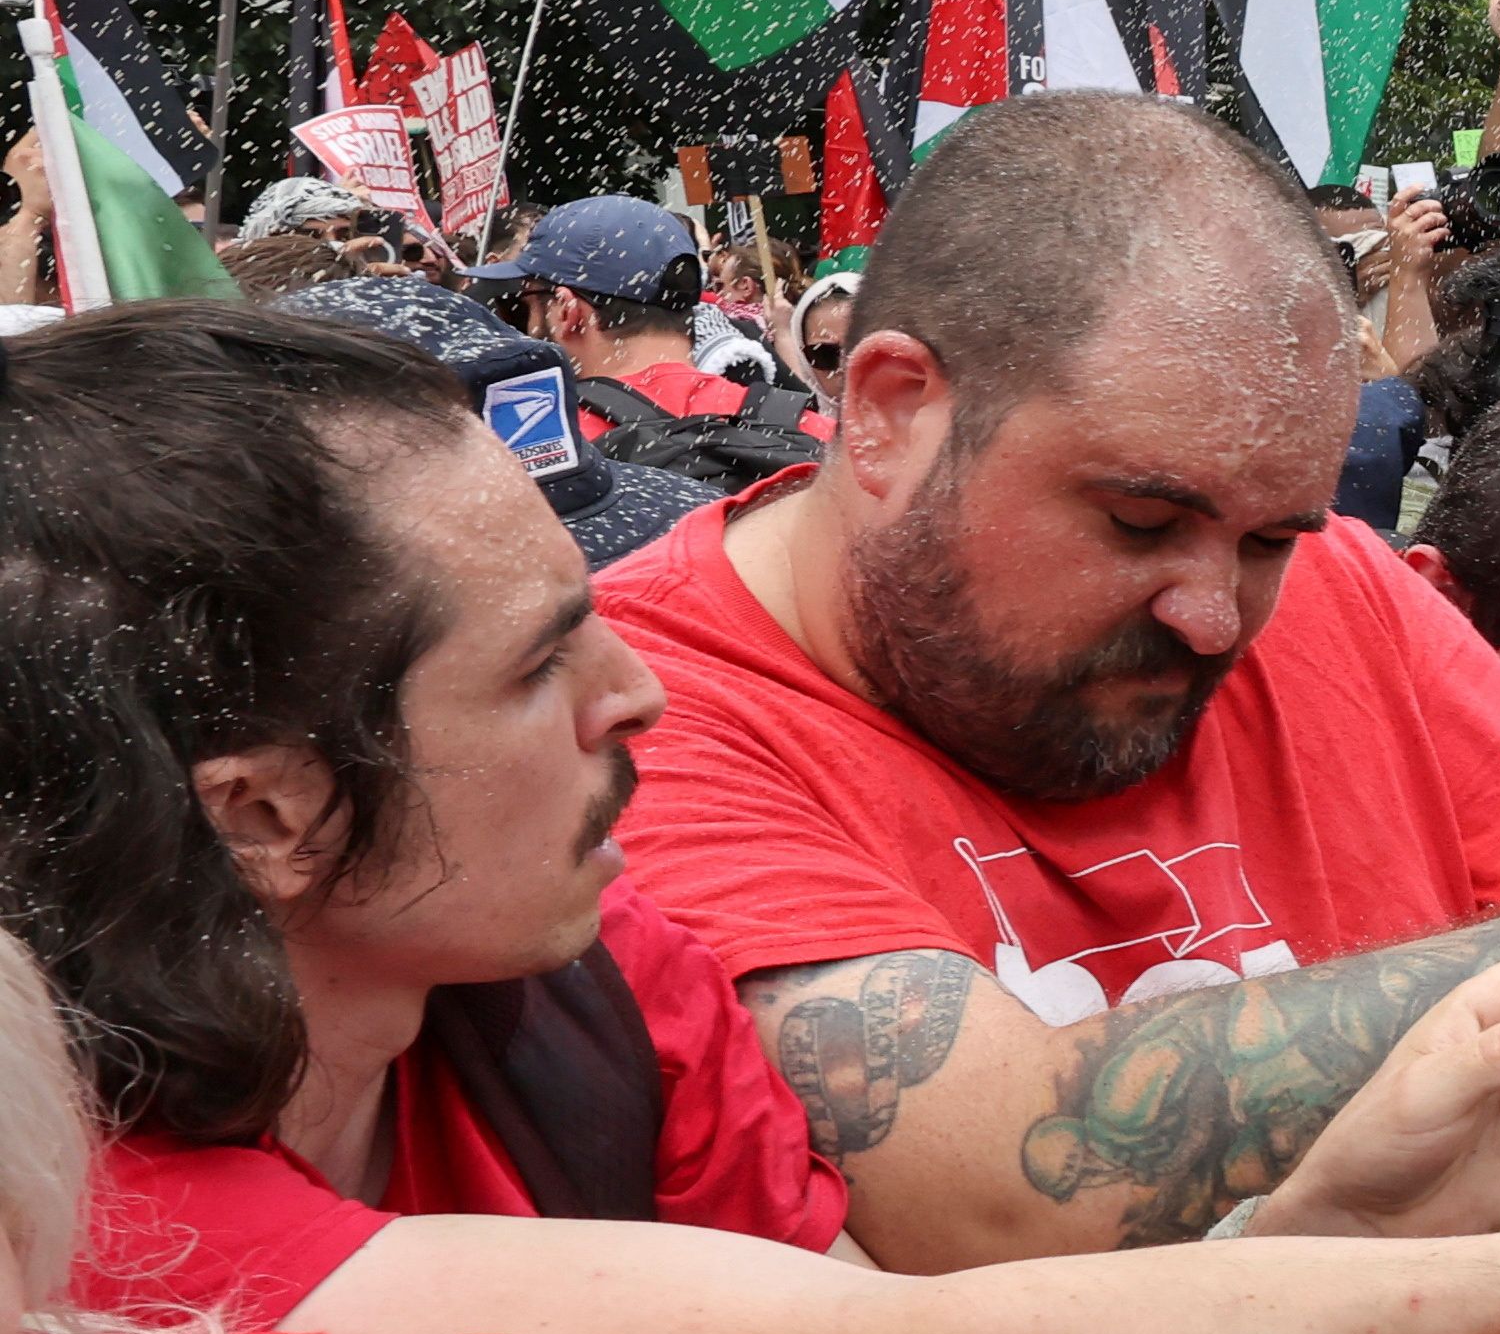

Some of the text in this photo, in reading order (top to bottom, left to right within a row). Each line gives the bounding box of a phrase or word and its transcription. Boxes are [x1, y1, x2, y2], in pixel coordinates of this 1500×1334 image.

[451, 46, 488, 97] ALL
[309, 115, 353, 141] STOP
[456, 83, 493, 134] AID
[323, 131, 405, 168] ISRAEL
